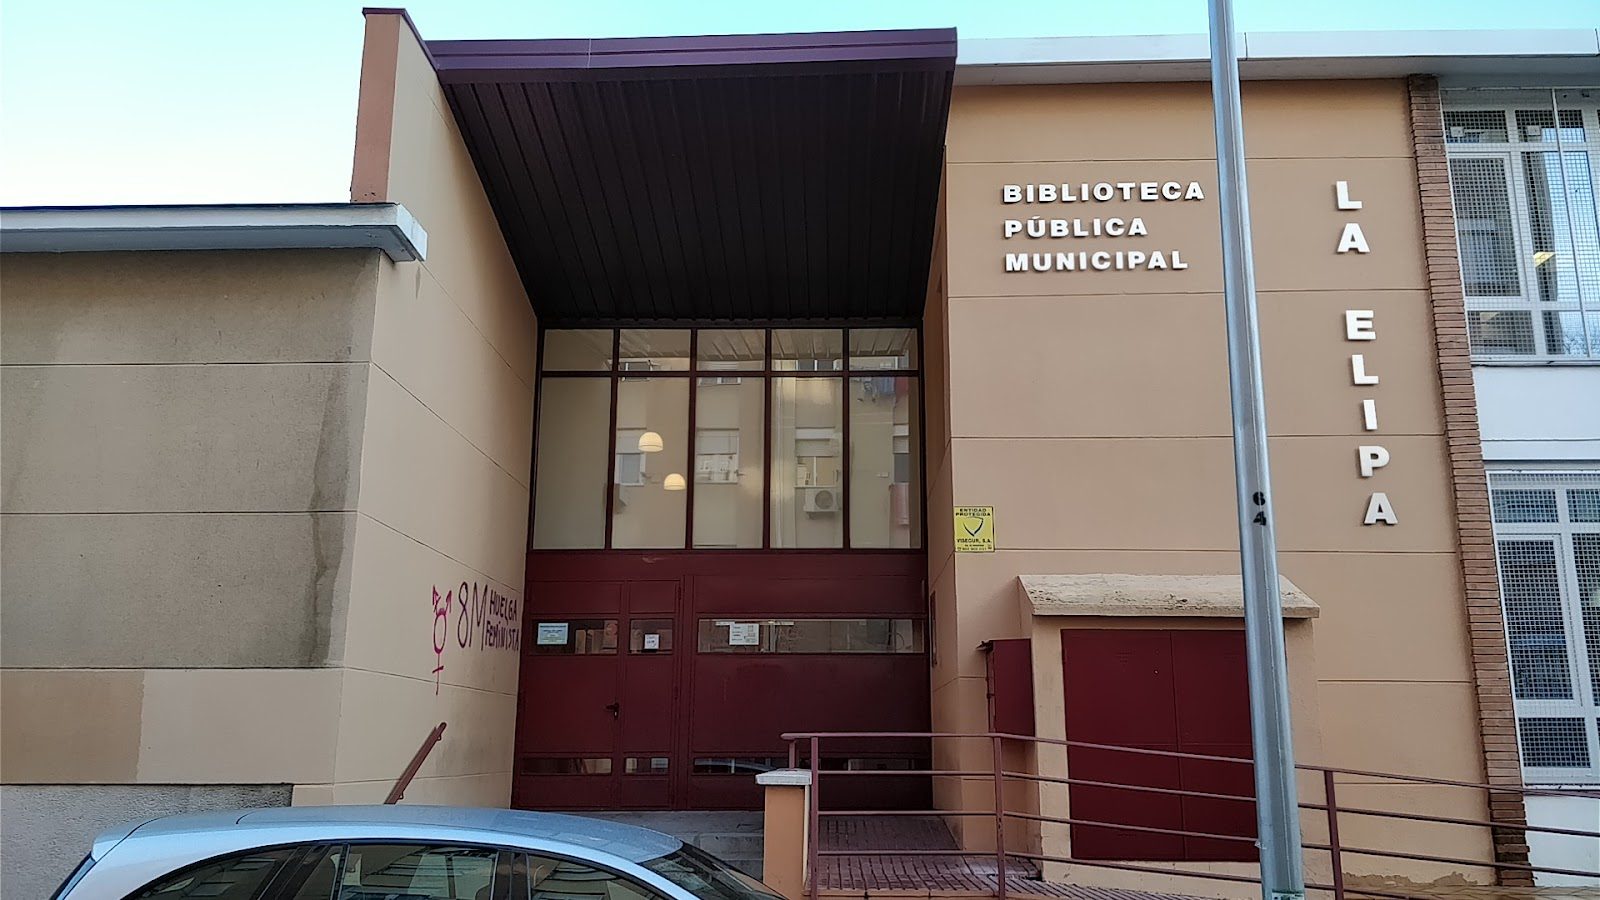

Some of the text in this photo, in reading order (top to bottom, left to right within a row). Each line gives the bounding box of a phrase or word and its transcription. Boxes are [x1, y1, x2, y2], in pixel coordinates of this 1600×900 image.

[1003, 182, 1205, 203] BIBLIOTECA
[1004, 215, 1148, 239] PÚBLICA
[1005, 250, 1189, 272] MUNICIPAL
[1336, 180, 1398, 525] LA ELIPA
[457, 581, 488, 652] 8M
[489, 589, 517, 625] HUELGA
